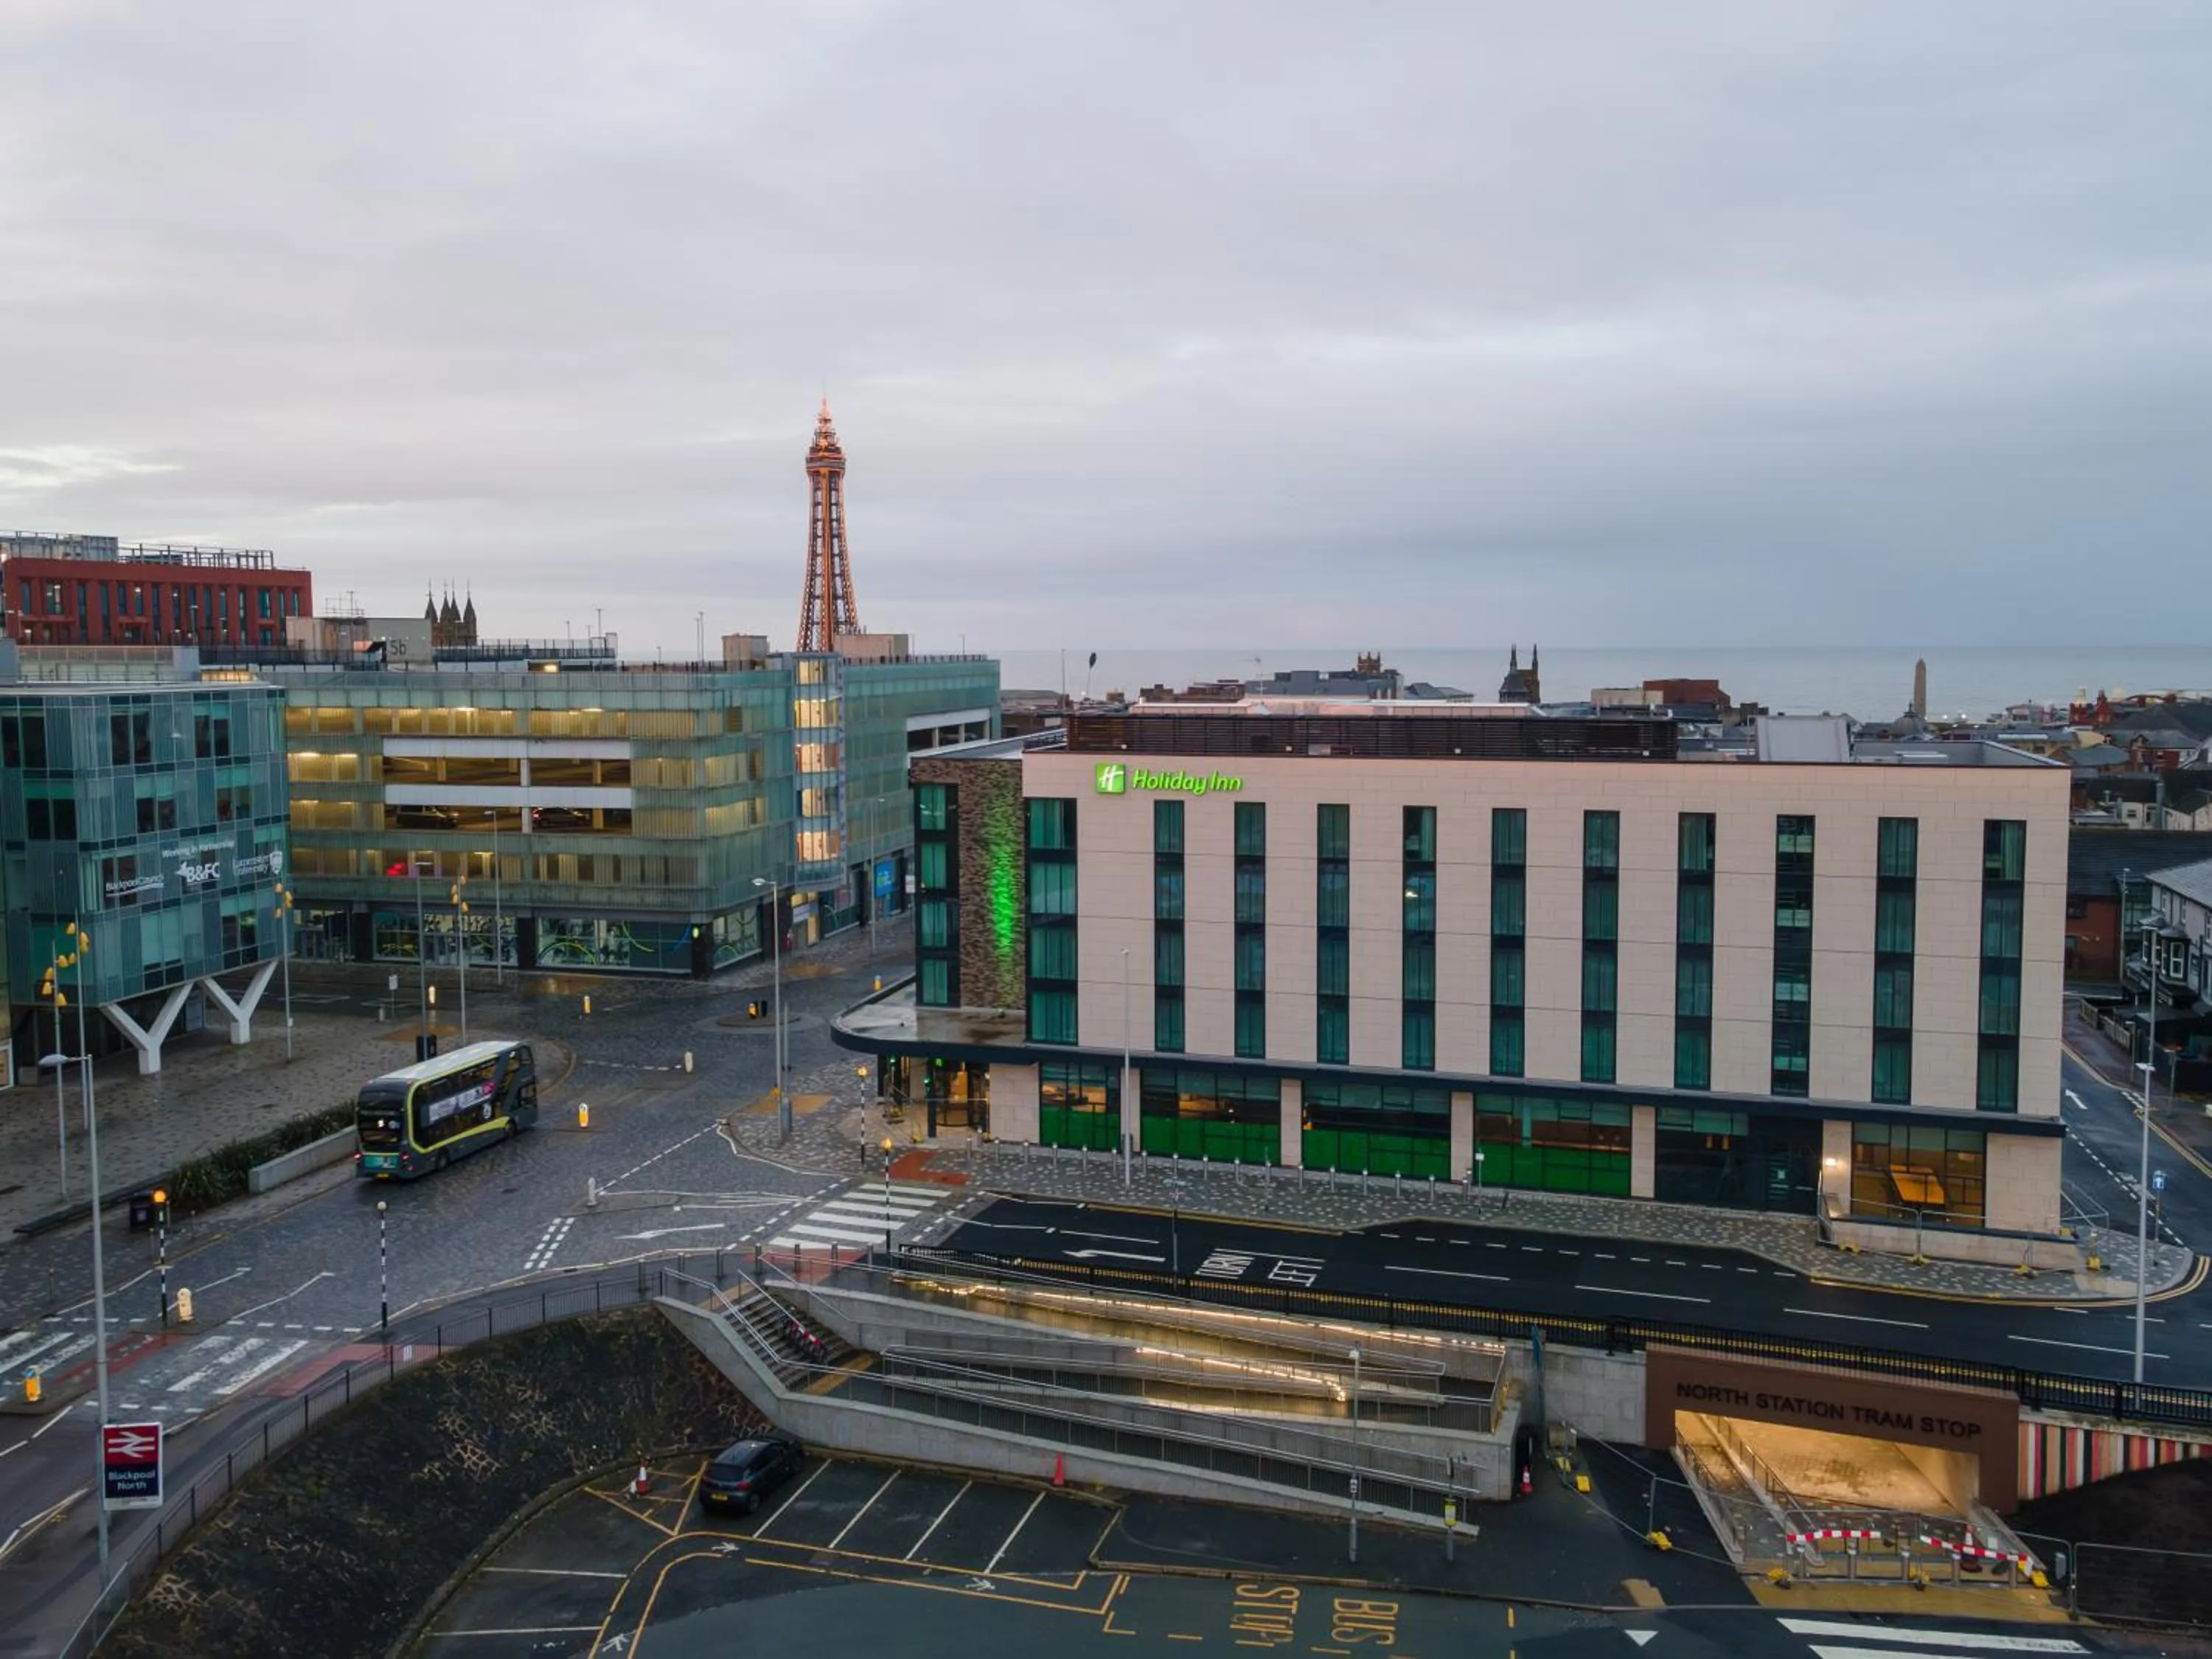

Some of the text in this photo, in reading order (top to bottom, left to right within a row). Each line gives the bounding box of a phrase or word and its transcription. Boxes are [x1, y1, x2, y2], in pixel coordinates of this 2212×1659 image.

[1133, 769, 1207, 796] Holiday
[1211, 771, 1242, 791] Inn
[187, 861, 220, 883] B&FC
[1194, 1252, 1255, 1279] TURN
[1267, 1259, 1322, 1287] LEFT
[1676, 1382, 1982, 1440] NORTH STATION TRAM STOP
[108, 1469, 156, 1481] Blackpool
[117, 1481, 147, 1491] North
[1332, 1598, 1399, 1644] BUS
